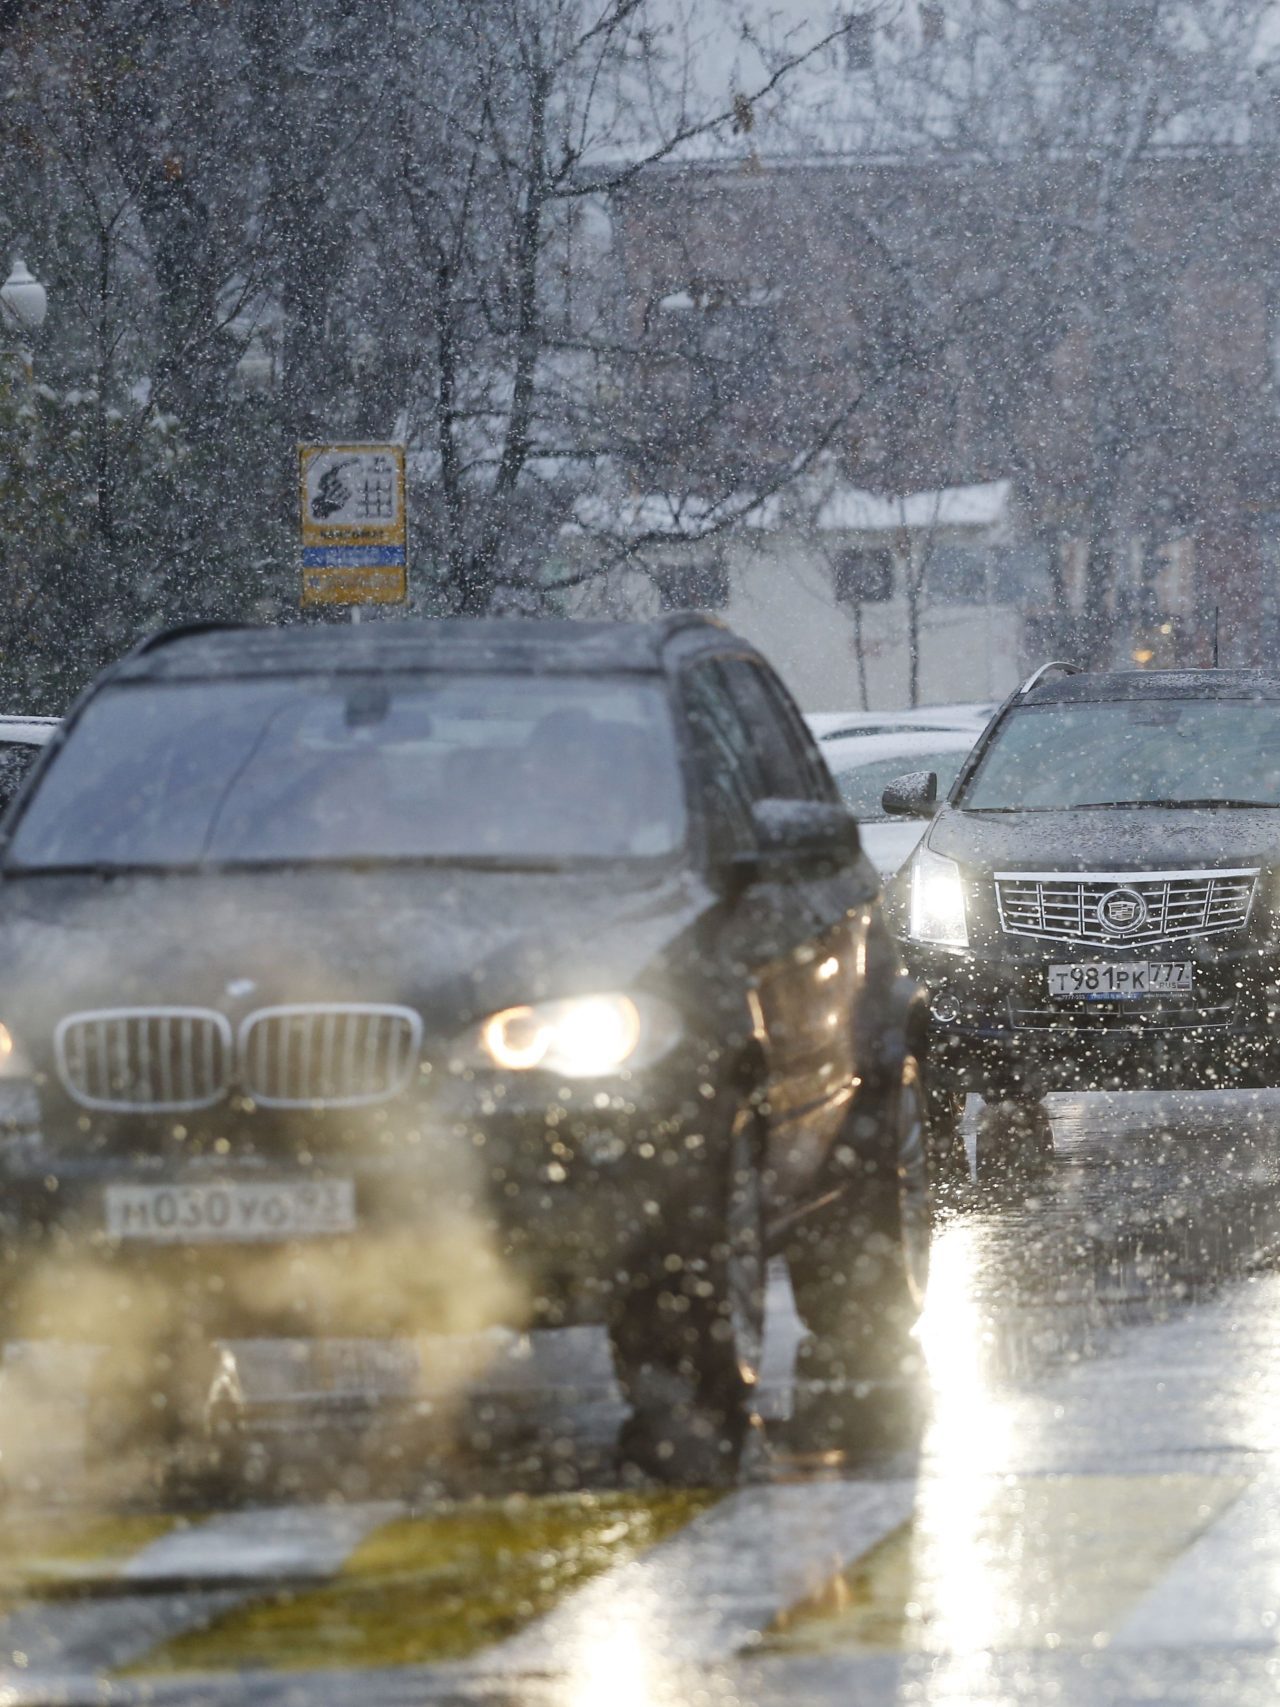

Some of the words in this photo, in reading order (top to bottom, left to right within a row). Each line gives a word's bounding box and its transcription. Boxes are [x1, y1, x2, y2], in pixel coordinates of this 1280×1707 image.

[1056, 966, 1145, 991] Т981РК
[1150, 964, 1186, 982] 777
[1159, 981, 1177, 989] RUS
